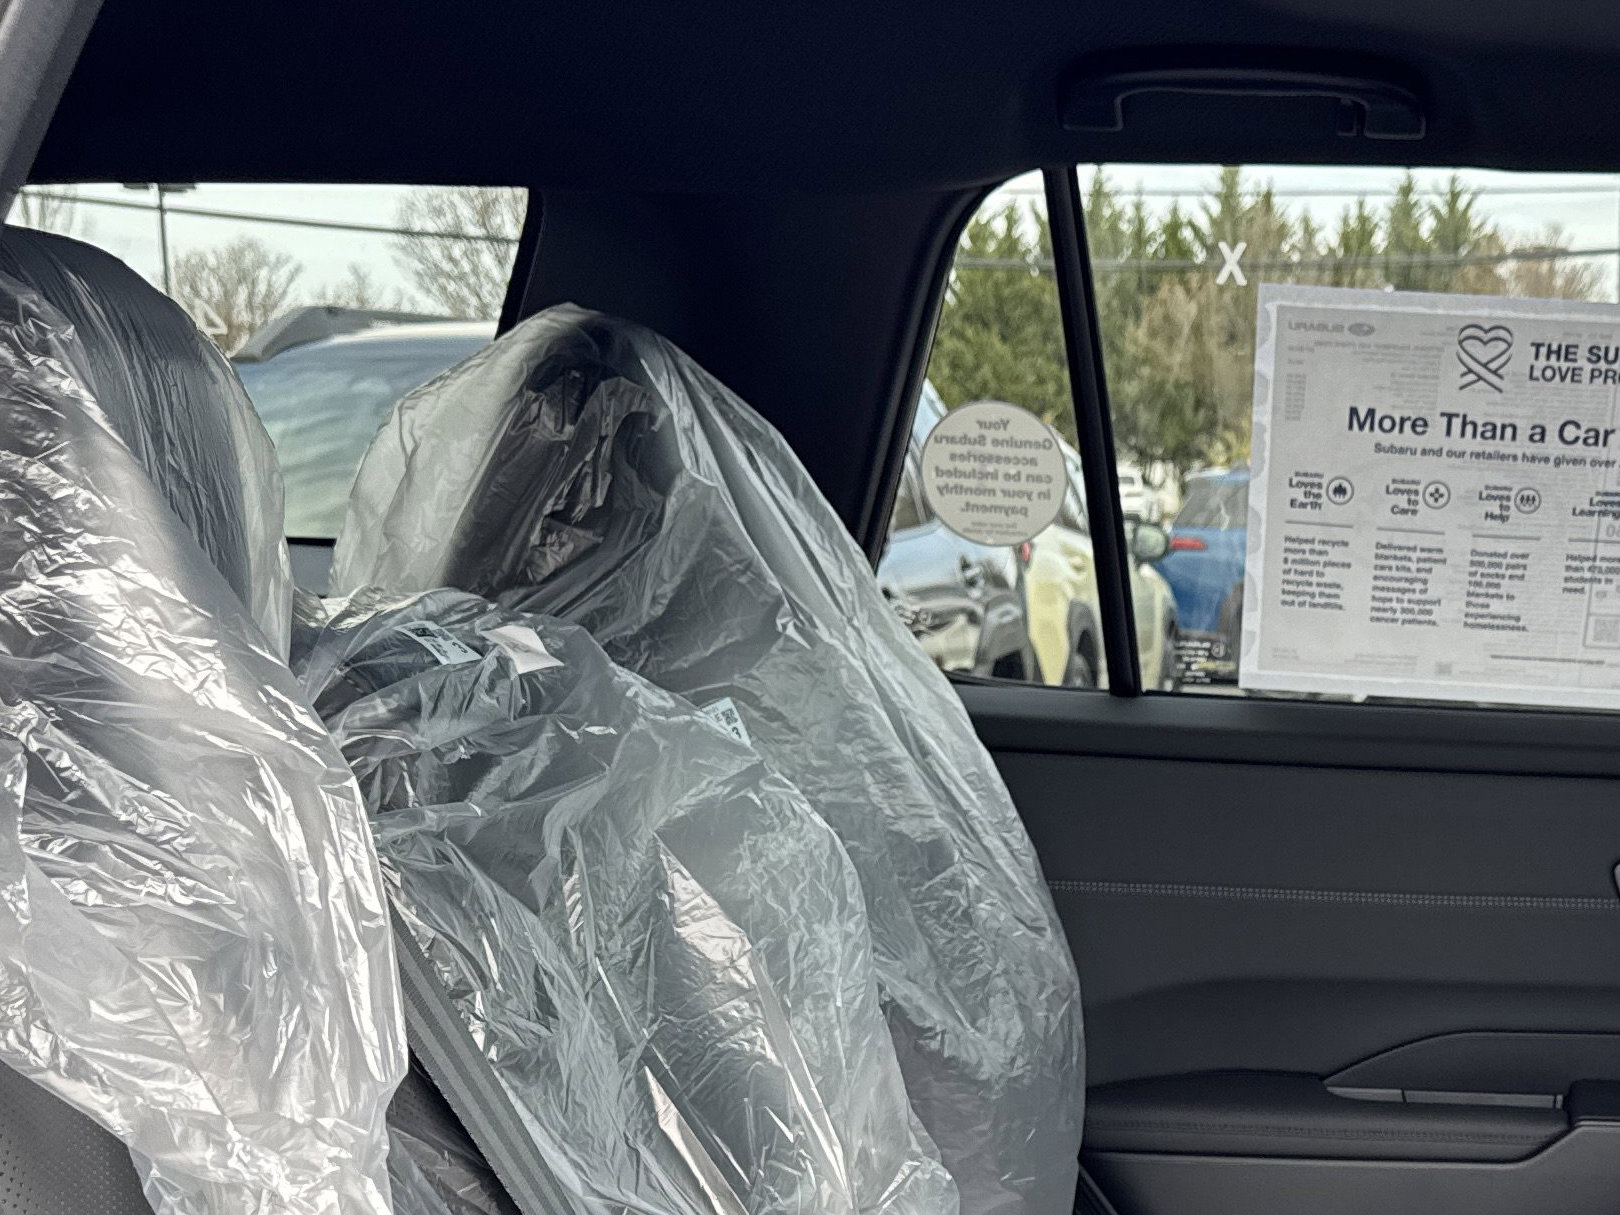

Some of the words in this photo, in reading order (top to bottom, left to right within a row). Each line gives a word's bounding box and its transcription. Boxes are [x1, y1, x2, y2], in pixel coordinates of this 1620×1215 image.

[1530, 342, 1579, 363] THE
[1529, 365, 1583, 384] LOVE
[1348, 406, 1429, 436] More
[1440, 412, 1517, 442] Than
[1528, 424, 1546, 444] a
[1558, 420, 1616, 448] Car
[1374, 442, 1417, 457] Subaru
[1420, 446, 1443, 458] and
[1446, 449, 1466, 459] our
[1470, 450, 1518, 463] retailers
[1521, 452, 1550, 465] have
[1554, 455, 1586, 468] given
[1590, 458, 1616, 469] over
[1289, 478, 1323, 490] Loves
[1303, 490, 1322, 500] the
[1386, 484, 1420, 497] Loves
[1479, 490, 1511, 502] Loves
[1290, 498, 1323, 511] Earth
[1407, 497, 1419, 506] to
[1499, 503, 1511, 512] to
[1390, 505, 1418, 516] Care
[1484, 511, 1510, 524] Help
[1284, 535, 1315, 547] Helped
